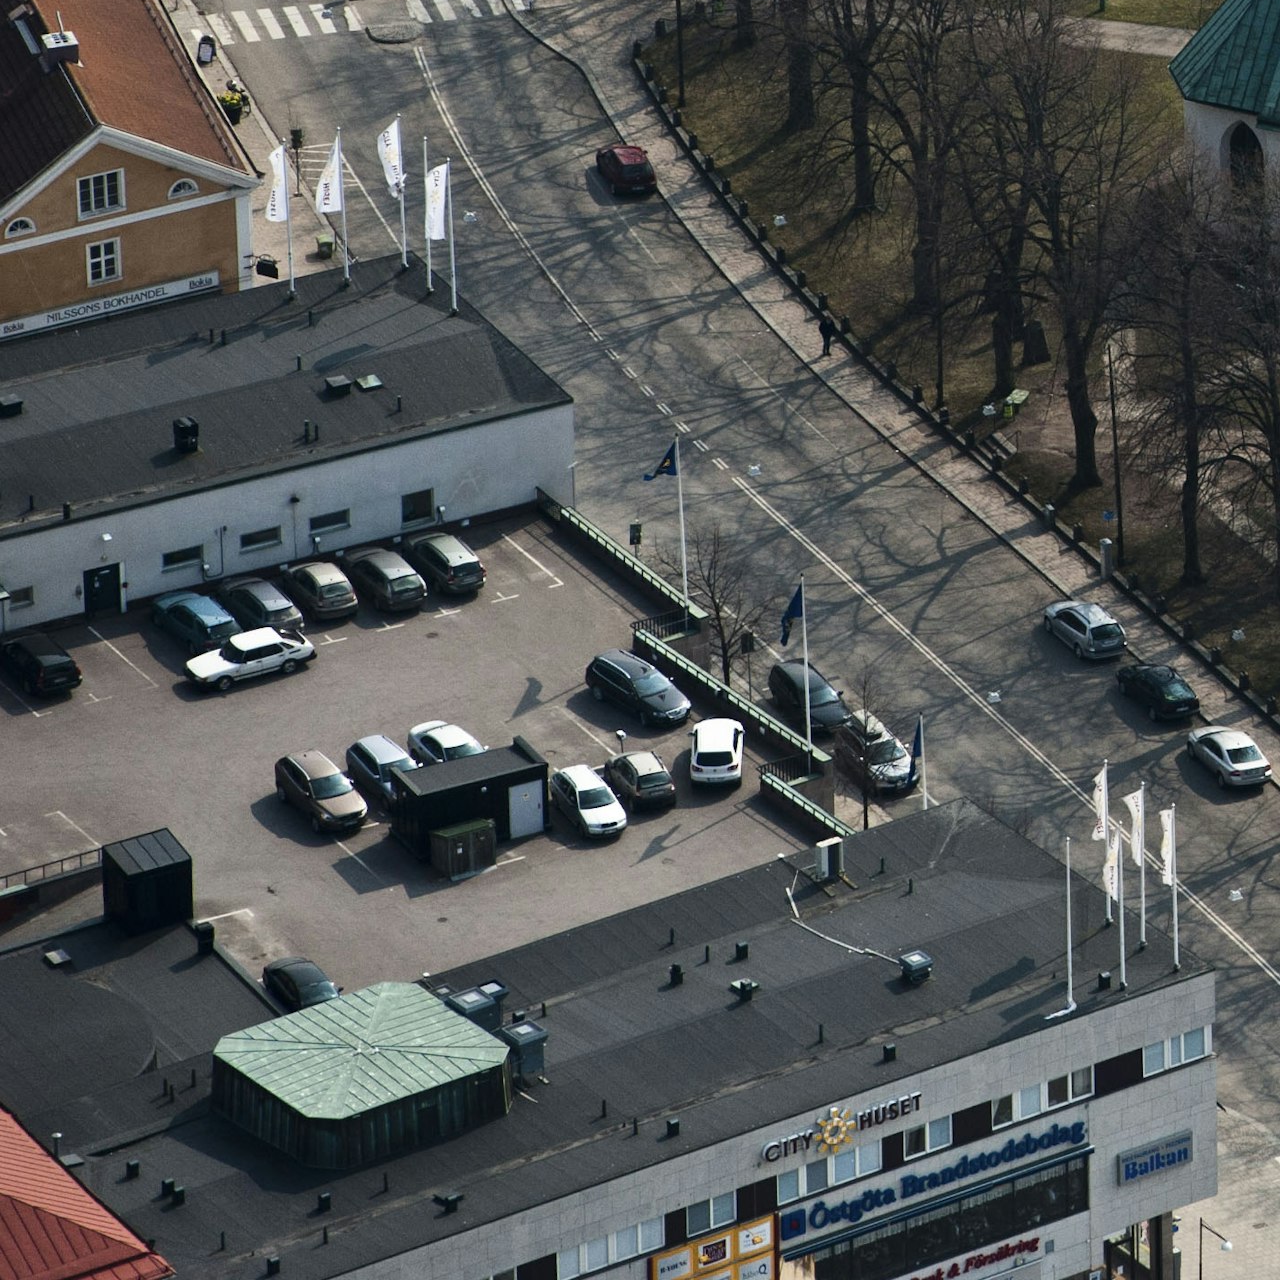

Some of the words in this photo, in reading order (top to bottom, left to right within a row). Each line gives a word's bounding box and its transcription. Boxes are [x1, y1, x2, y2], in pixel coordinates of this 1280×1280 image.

[188, 277, 213, 290] Bokia
[46, 302, 101, 323] NILSSONS
[103, 287, 168, 310] BOKHANDEL
[3, 322, 25, 334] Bokia
[763, 1130, 814, 1163] CITY
[857, 1091, 922, 1131] HUSET
[808, 1186, 897, 1230] Östgöta
[900, 1122, 1087, 1199] Brandstodsbolag
[1125, 1147, 1189, 1181] Balkan
[946, 1262, 961, 1279] &
[962, 1236, 1040, 1273] Försäkring
